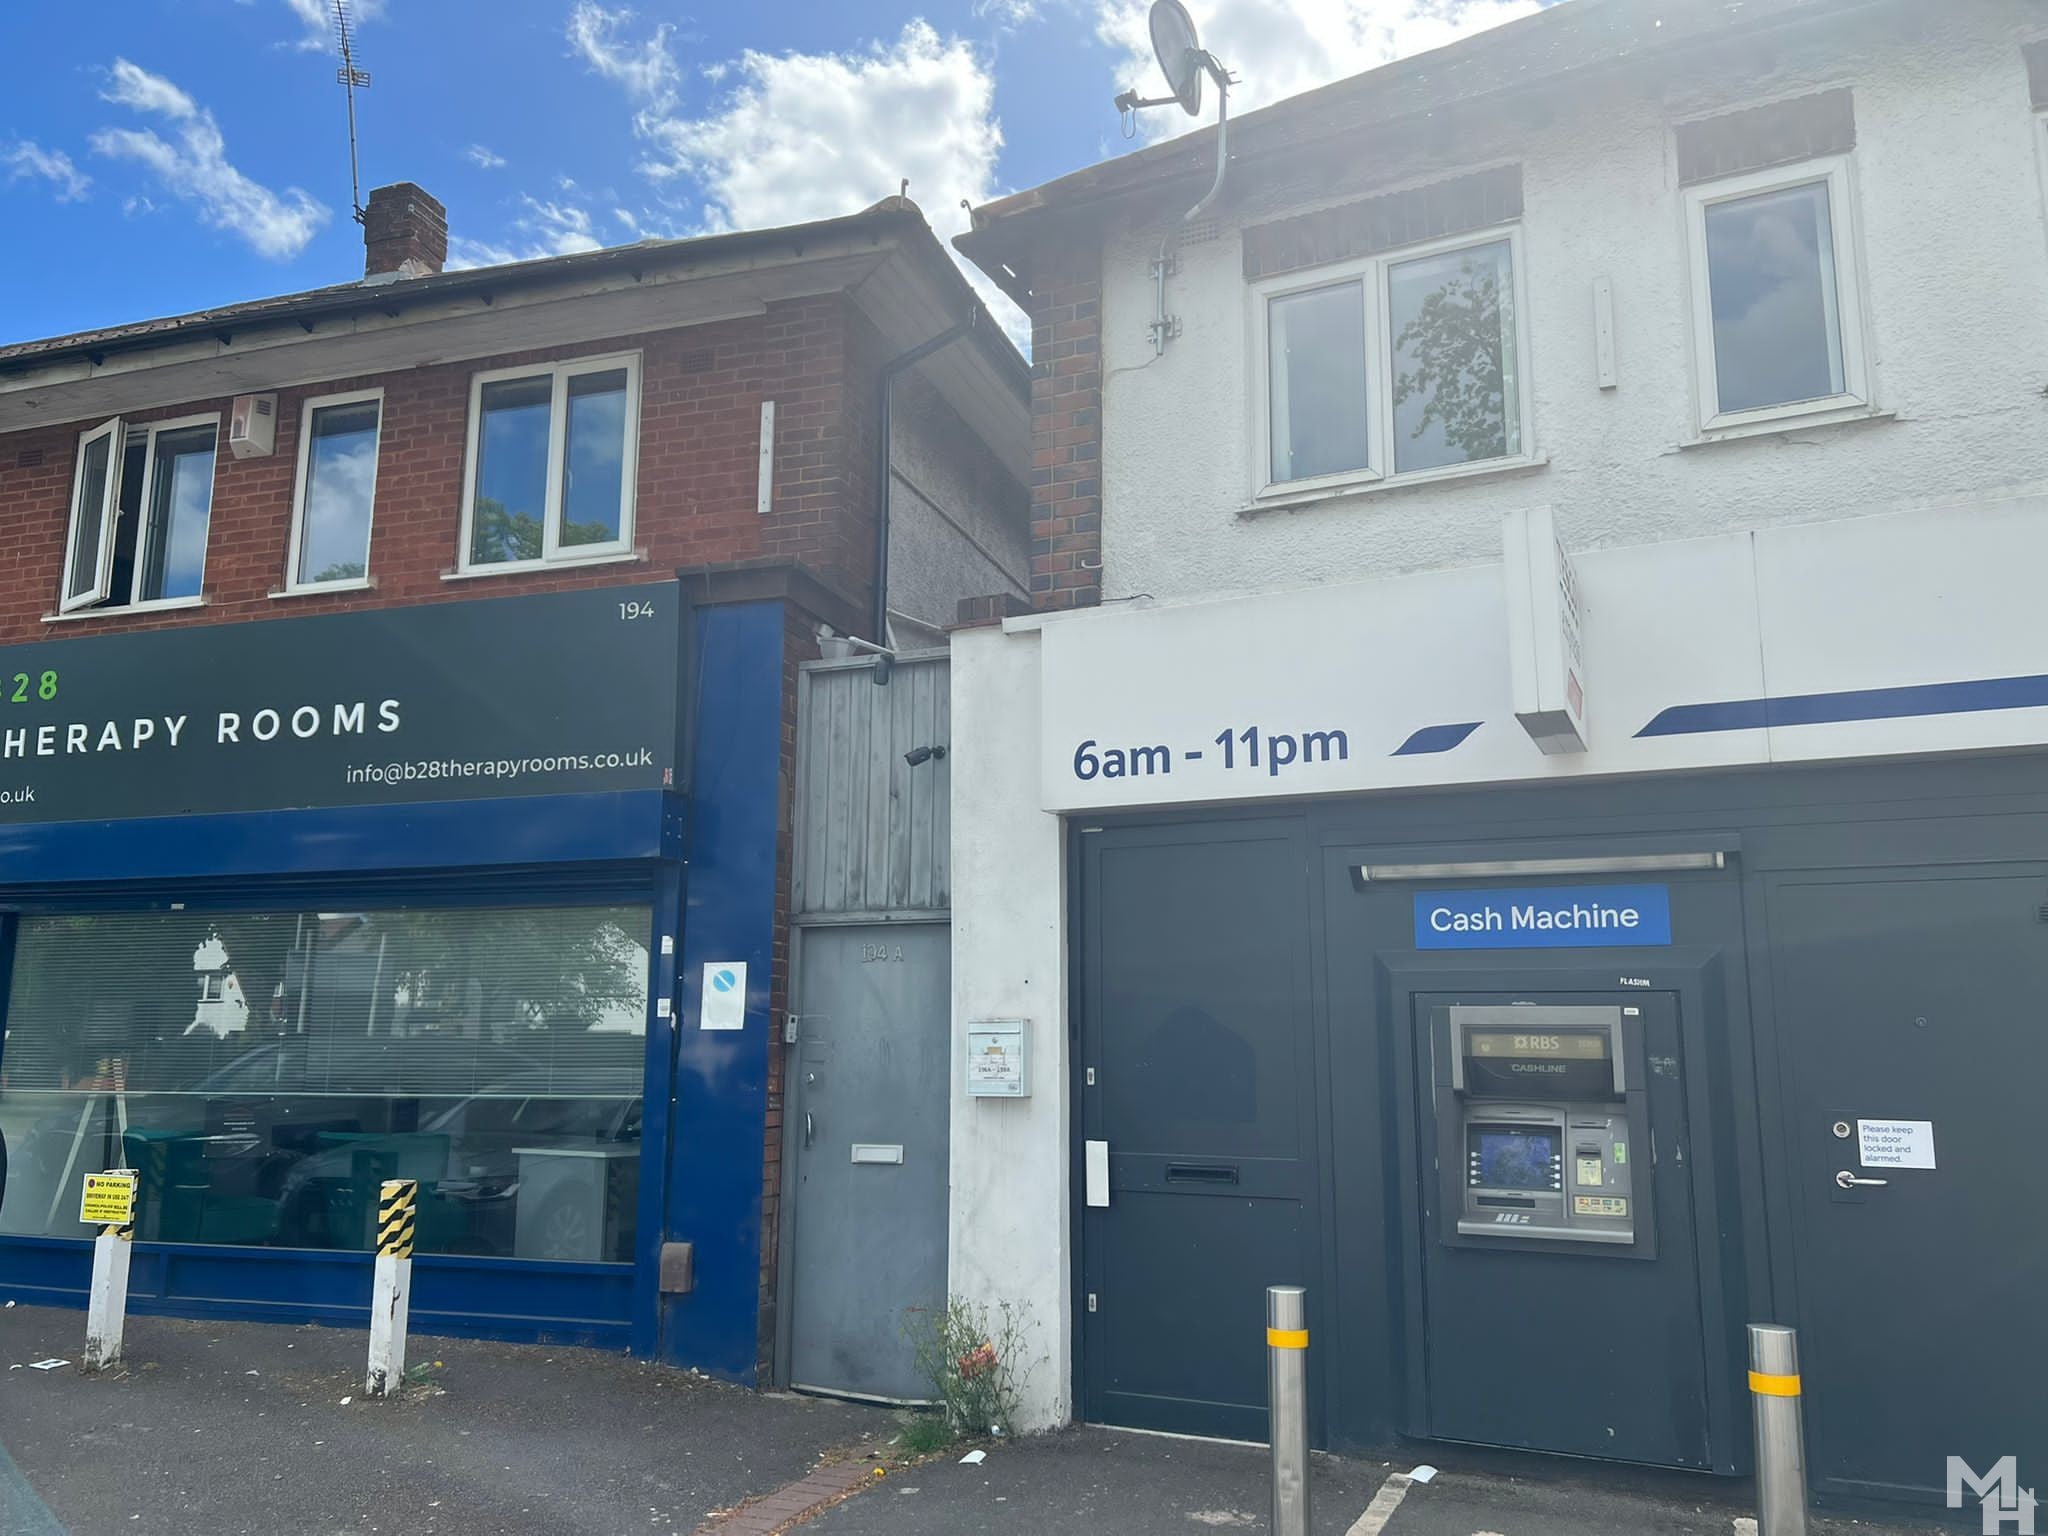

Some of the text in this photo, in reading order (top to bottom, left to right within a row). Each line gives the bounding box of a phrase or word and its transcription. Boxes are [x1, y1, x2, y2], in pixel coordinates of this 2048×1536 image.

[617, 600, 655, 620] 194
[0, 670, 58, 702] 28
[217, 699, 400, 743] ROOMS
[1073, 726, 1348, 780] 6am - 11pm
[346, 747, 653, 785] info@b28therapyrooms.co.uk
[1430, 903, 1640, 932] Cash Machine
[1529, 1035, 1560, 1050] RBS
[1511, 1063, 1568, 1073] CASHLINE
[1863, 1125, 1913, 1134] Please keep
[1881, 1135, 1902, 1143] door
